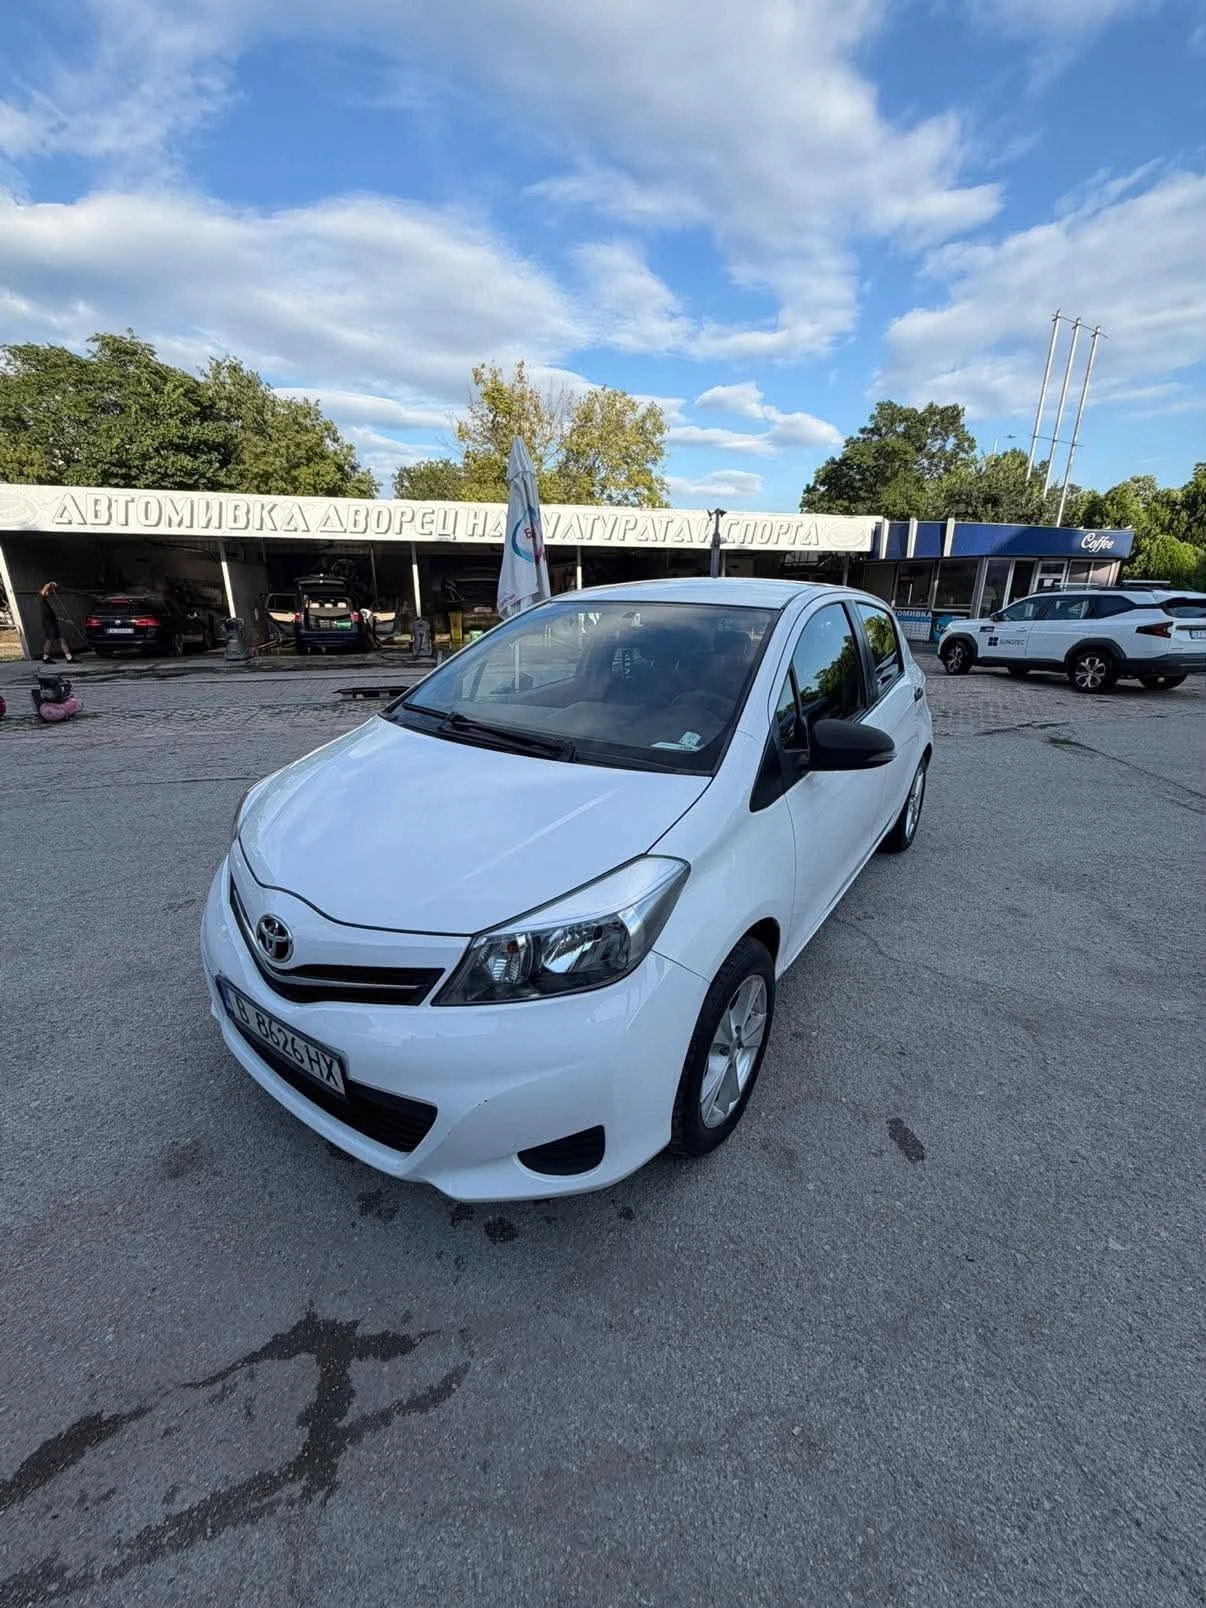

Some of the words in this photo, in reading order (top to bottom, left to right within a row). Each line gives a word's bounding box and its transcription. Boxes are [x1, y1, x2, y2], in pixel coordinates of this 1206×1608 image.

[53, 493, 310, 532] АВТОМИВКА
[315, 504, 455, 539] ДВОРЕЦ
[467, 507, 506, 537] НА
[542, 511, 693, 543] УЛТУРАТА
[722, 518, 819, 546] СПОРТА
[1081, 533, 1114, 552] Coffee
[234, 994, 250, 1025] B
[255, 1009, 304, 1065] 8626
[304, 1045, 340, 1088] HX
